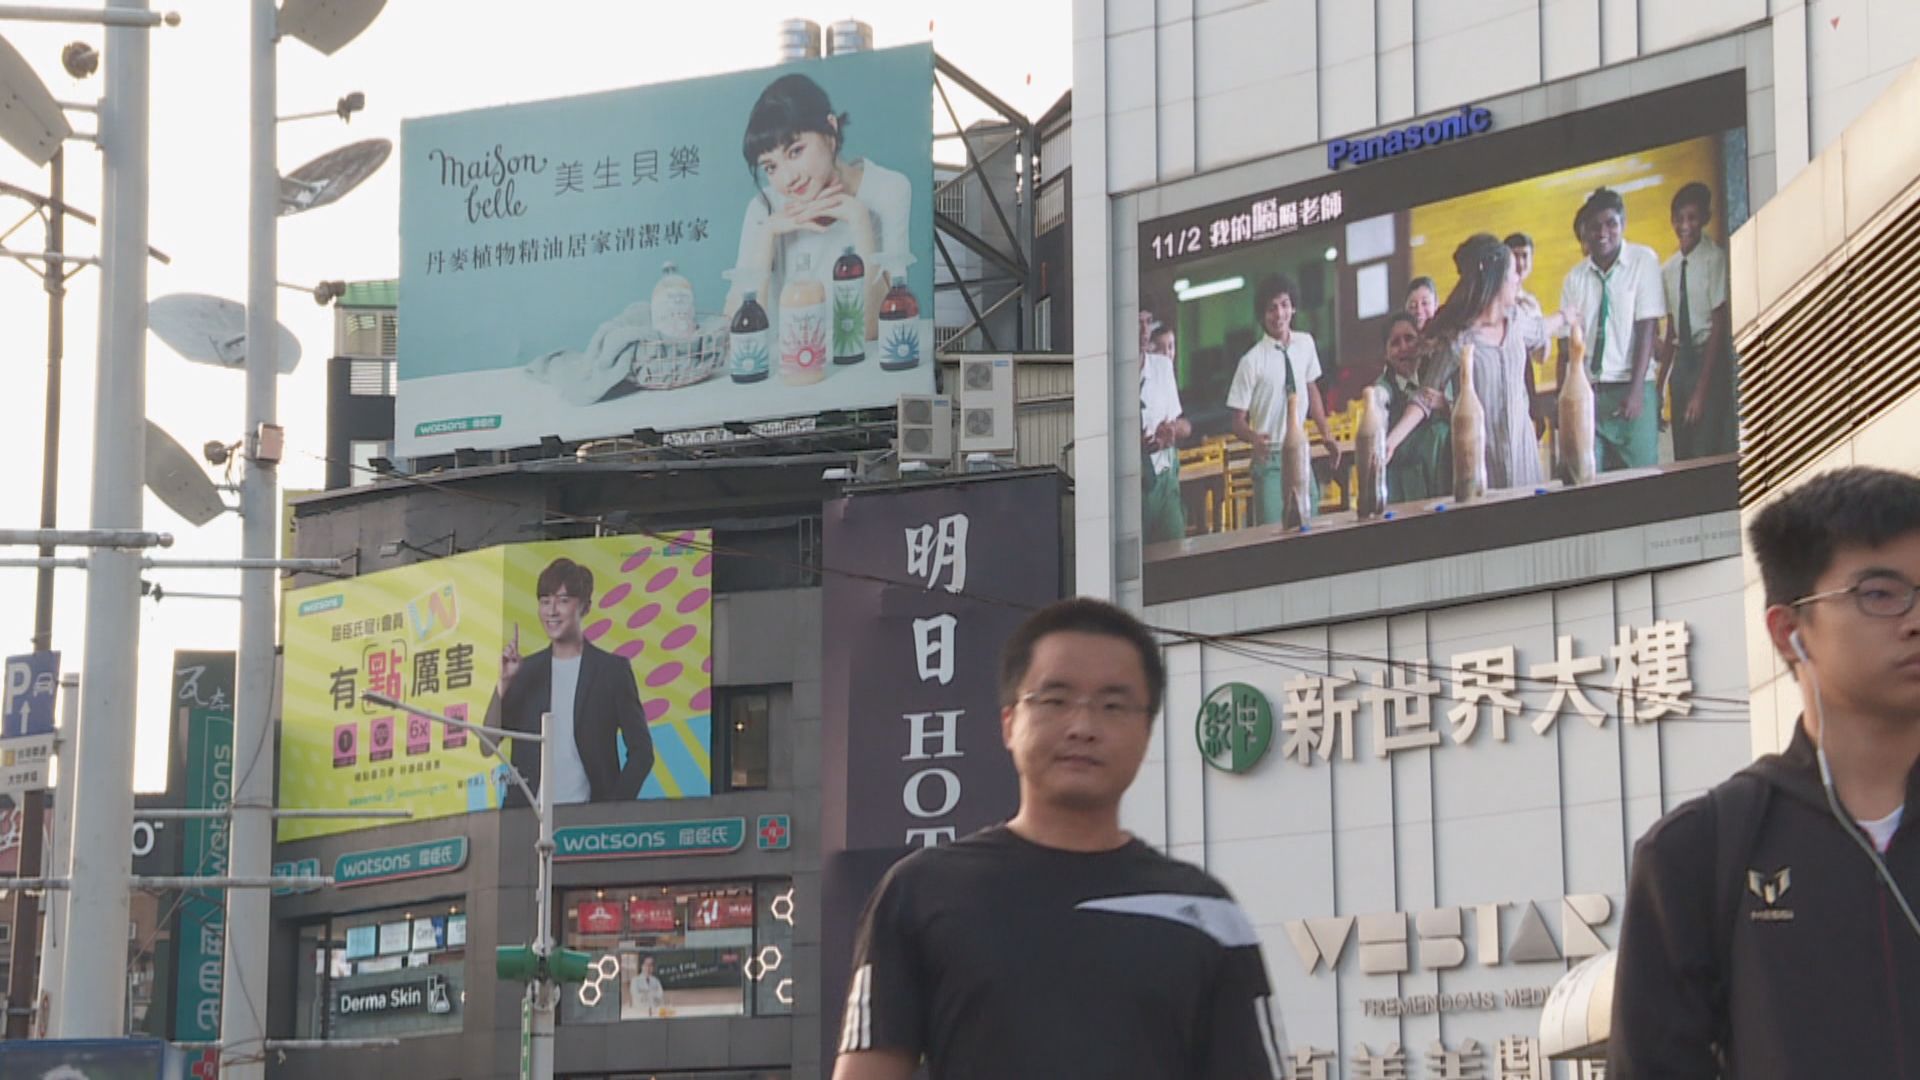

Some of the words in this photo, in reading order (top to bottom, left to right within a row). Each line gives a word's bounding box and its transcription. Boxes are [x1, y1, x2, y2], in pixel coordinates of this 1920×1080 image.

[1327, 104, 1492, 171] Panasonic
[554, 144, 700, 196] 美生貝樂
[465, 179, 528, 223] belle
[426, 217, 709, 276] 丹麥植物精油居家清潔專家
[1151, 226, 1202, 260] 11/2
[905, 514, 970, 685] 明日
[5, 662, 32, 715] P
[1281, 619, 1695, 766] 新世界大樓
[564, 831, 666, 851] watsons
[678, 826, 728, 846] 屈臣氏
[343, 854, 411, 878] watsons
[1282, 893, 1612, 976] WESTAR
[341, 994, 387, 1013] Derma
[390, 987, 421, 1008] Skin
[1360, 991, 1496, 1018] TREMENDOUS
